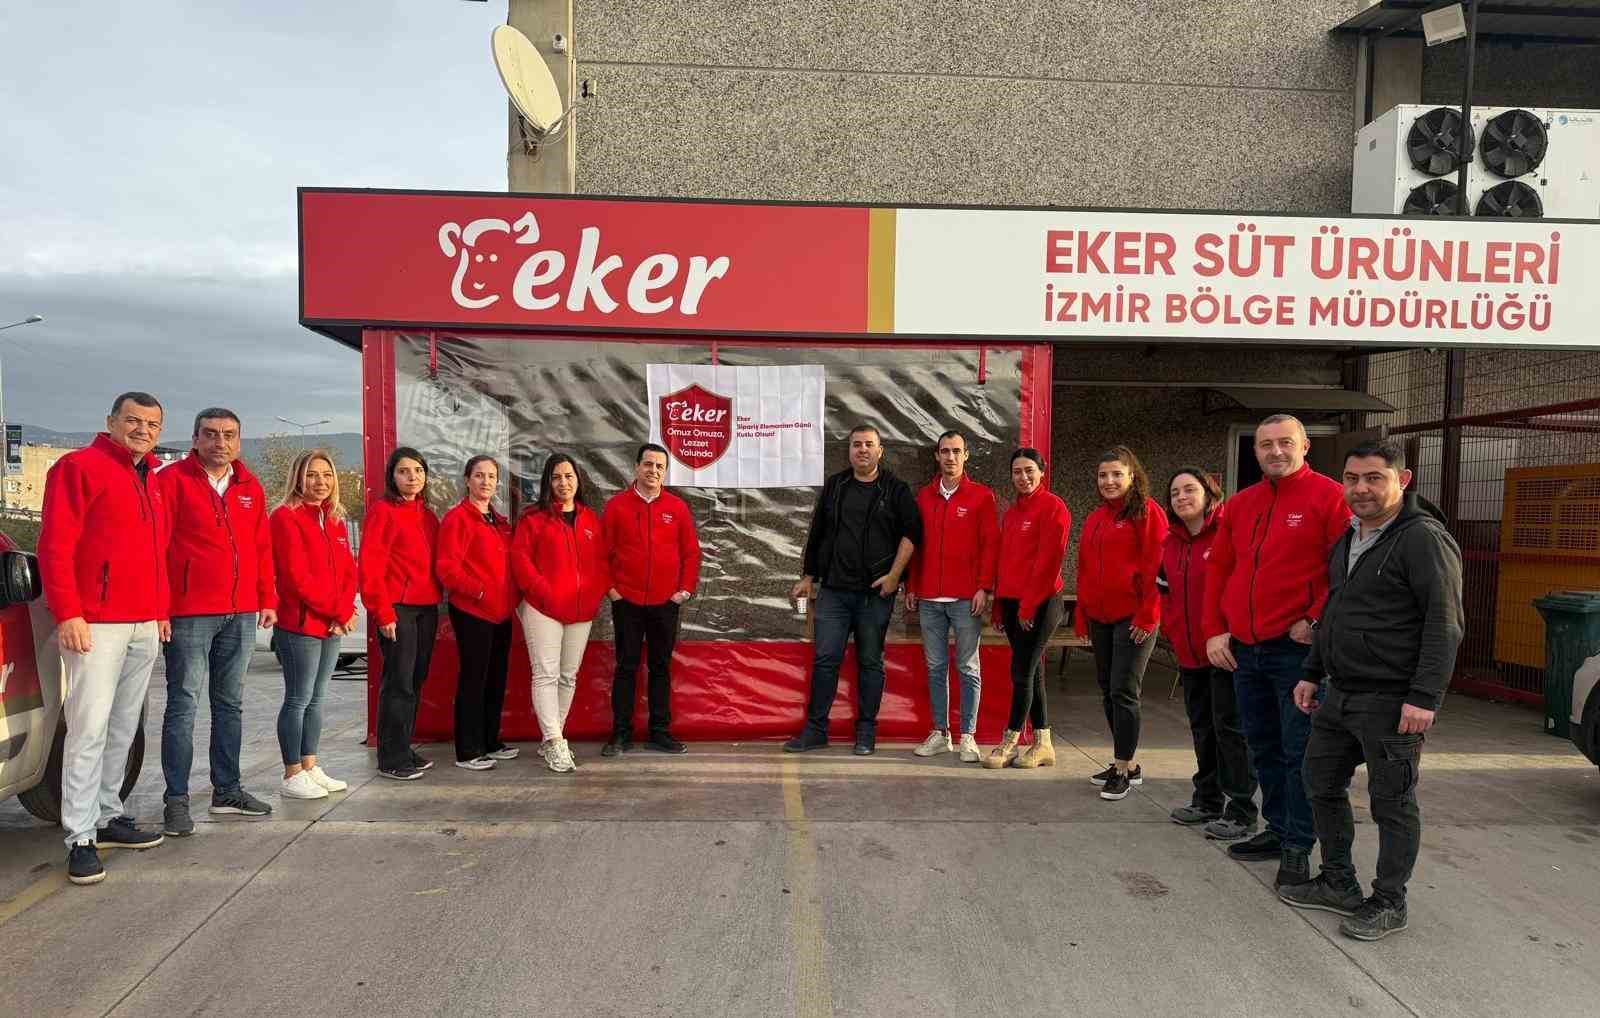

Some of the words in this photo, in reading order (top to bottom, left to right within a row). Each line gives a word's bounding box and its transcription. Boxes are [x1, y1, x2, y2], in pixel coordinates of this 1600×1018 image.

[1046, 230, 1177, 276] EKER
[1193, 222, 1296, 278] SÜT
[1311, 225, 1561, 285] ÜRÜNLERİ
[512, 226, 730, 315] eker
[1044, 283, 1151, 323] İZMİR
[1165, 286, 1296, 326] BÖLGE
[1309, 289, 1552, 332] MÜDÜRLÜĞÜ
[681, 403, 728, 423] eker
[667, 427, 692, 437] Omuz
[693, 428, 725, 439] Omuza,
[679, 448, 713, 458] Yolunda
[682, 439, 709, 448] Lezzet
